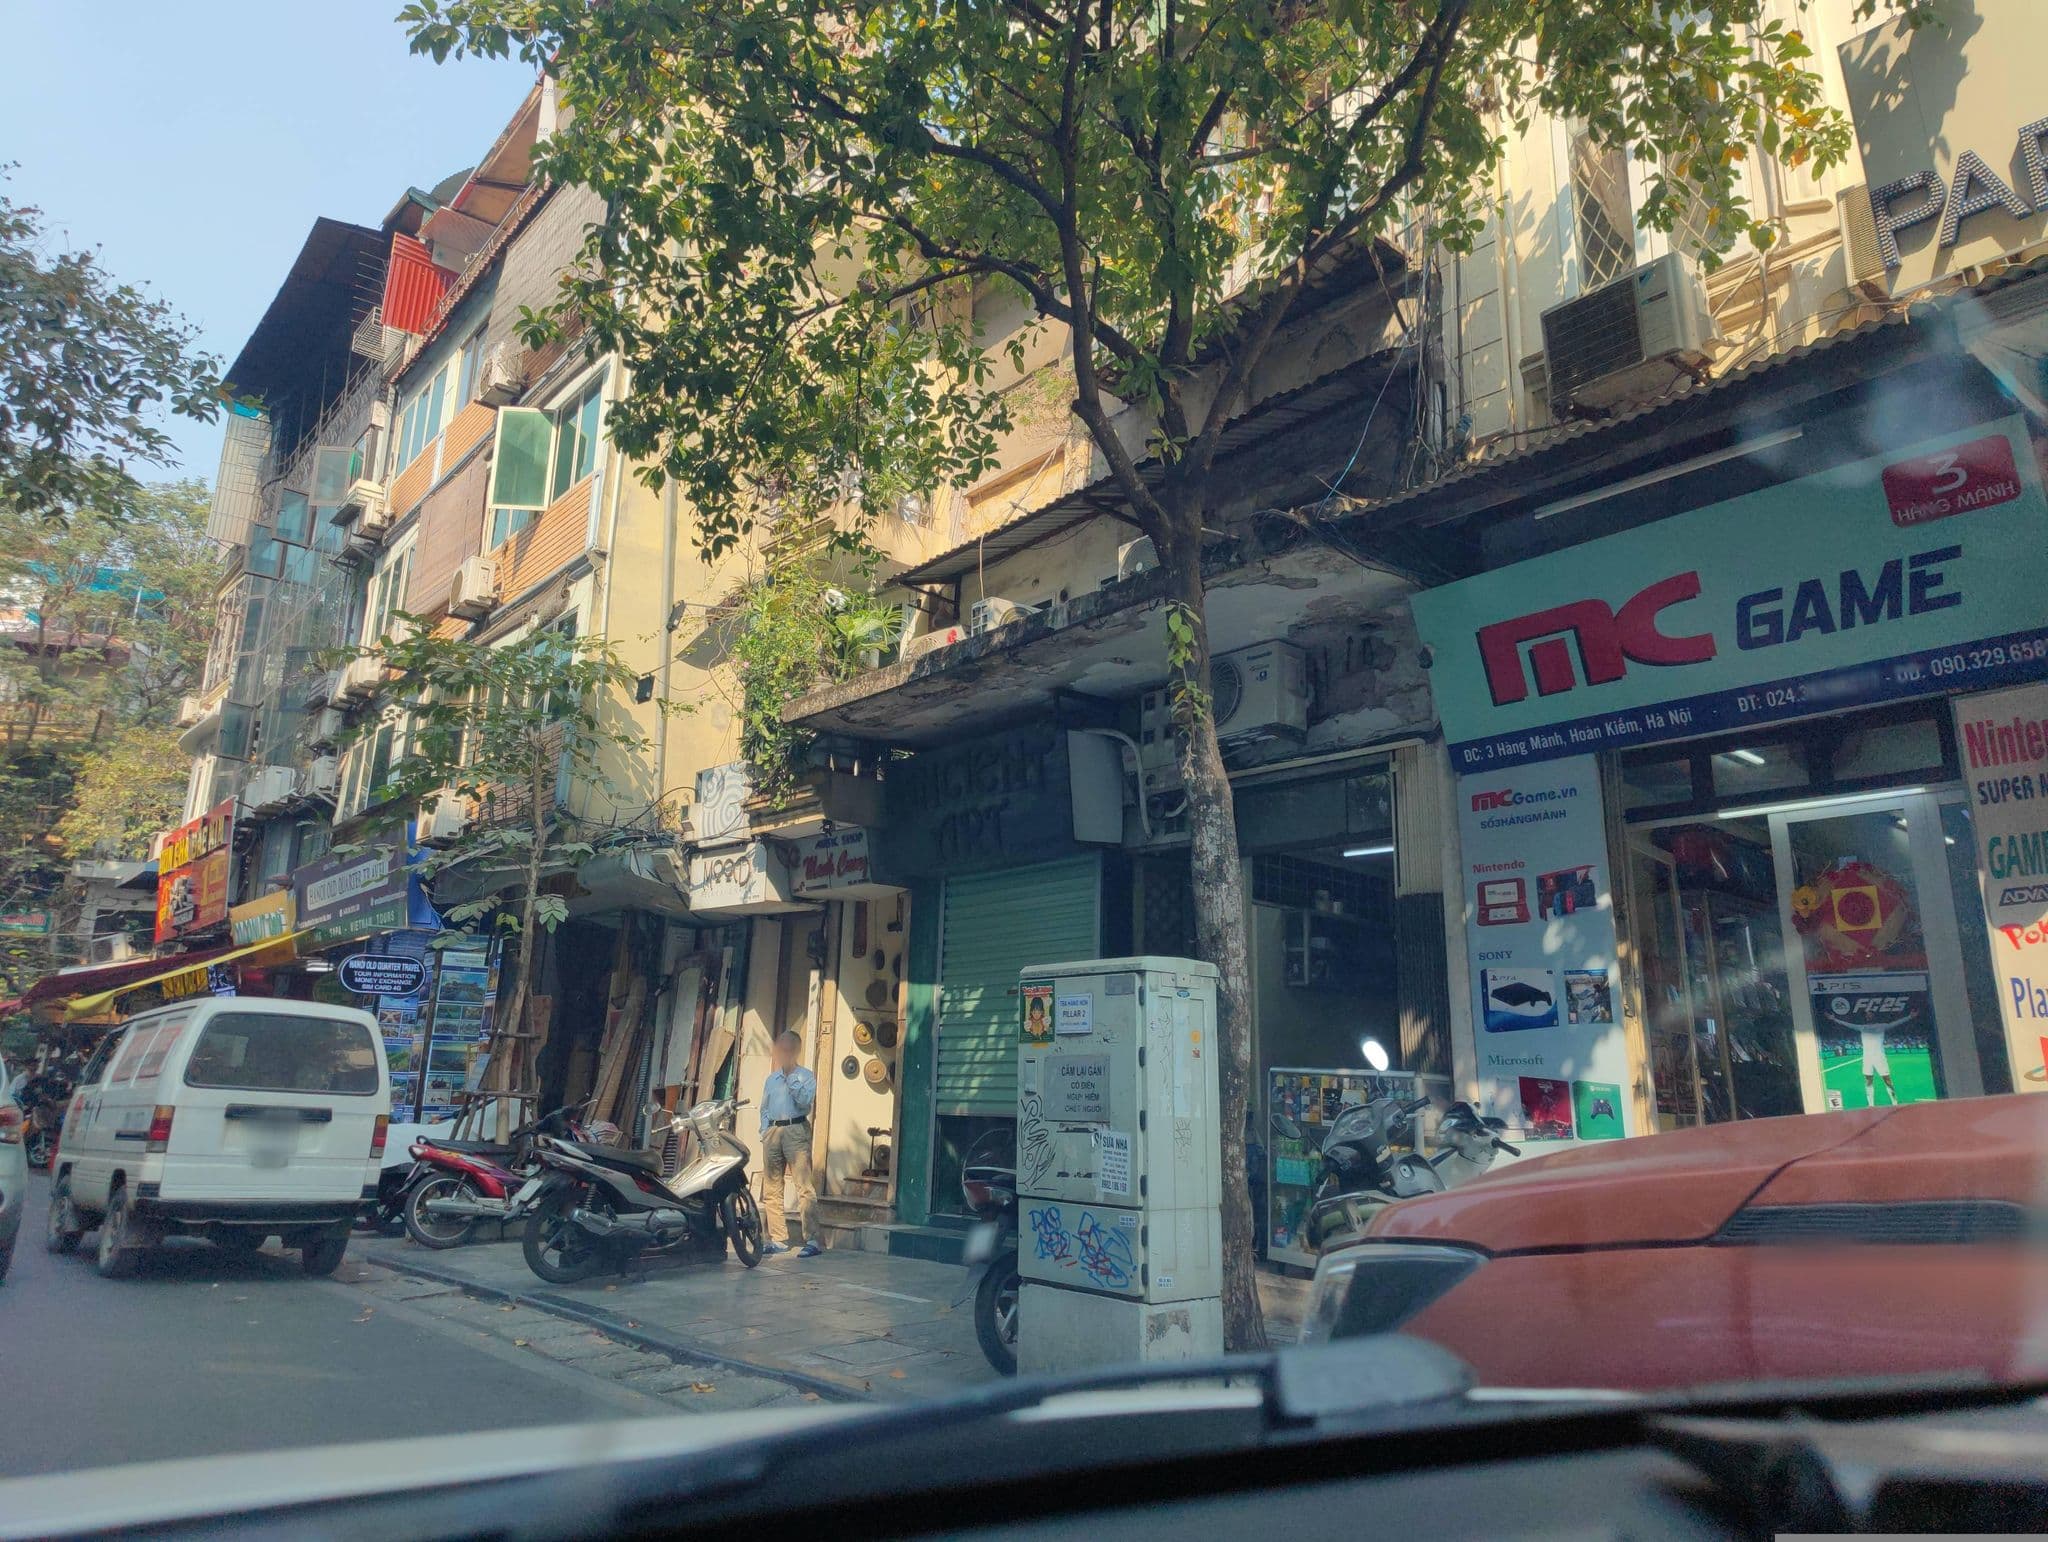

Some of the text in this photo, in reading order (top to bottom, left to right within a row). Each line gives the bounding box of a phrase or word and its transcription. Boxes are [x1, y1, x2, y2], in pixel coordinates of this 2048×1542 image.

[1928, 453, 1968, 495] 3
[1736, 545, 1962, 651] GAME
[1487, 744, 1495, 760] 3
[1498, 740, 1528, 758] Hàng
[1645, 713, 1666, 730] Hà
[1668, 707, 1693, 727] Nội
[1929, 637, 2048, 677] 090.329.658
[1977, 775, 2035, 805] SUPER
[1472, 859, 1526, 874] Nintendo
[1479, 950, 1514, 961] SONY
[2010, 976, 2048, 1018] Pla
[1487, 1055, 1544, 1066] Microsoft
